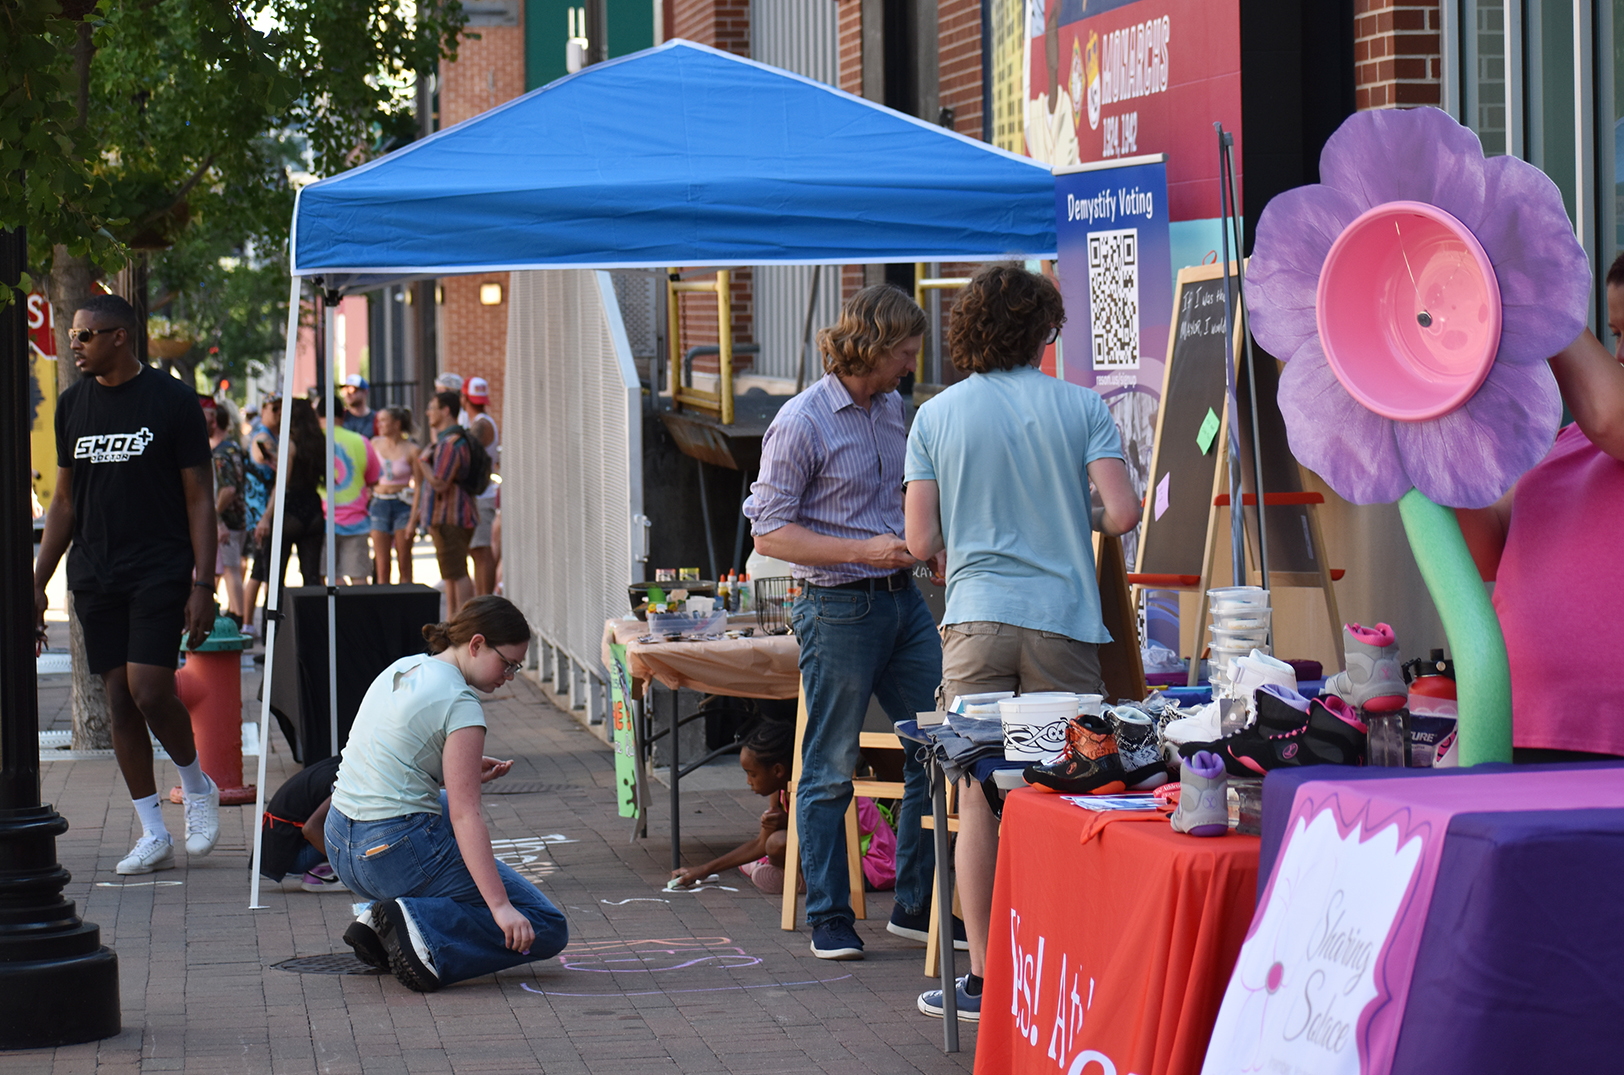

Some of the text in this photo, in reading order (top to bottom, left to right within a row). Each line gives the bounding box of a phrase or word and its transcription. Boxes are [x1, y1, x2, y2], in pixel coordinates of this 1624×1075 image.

[1101, 14, 1171, 106] MONARCHS
[1067, 185, 1154, 226] Demystify Voting
[1306, 888, 1374, 997] Sharing
[1282, 968, 1350, 1054] Solace
